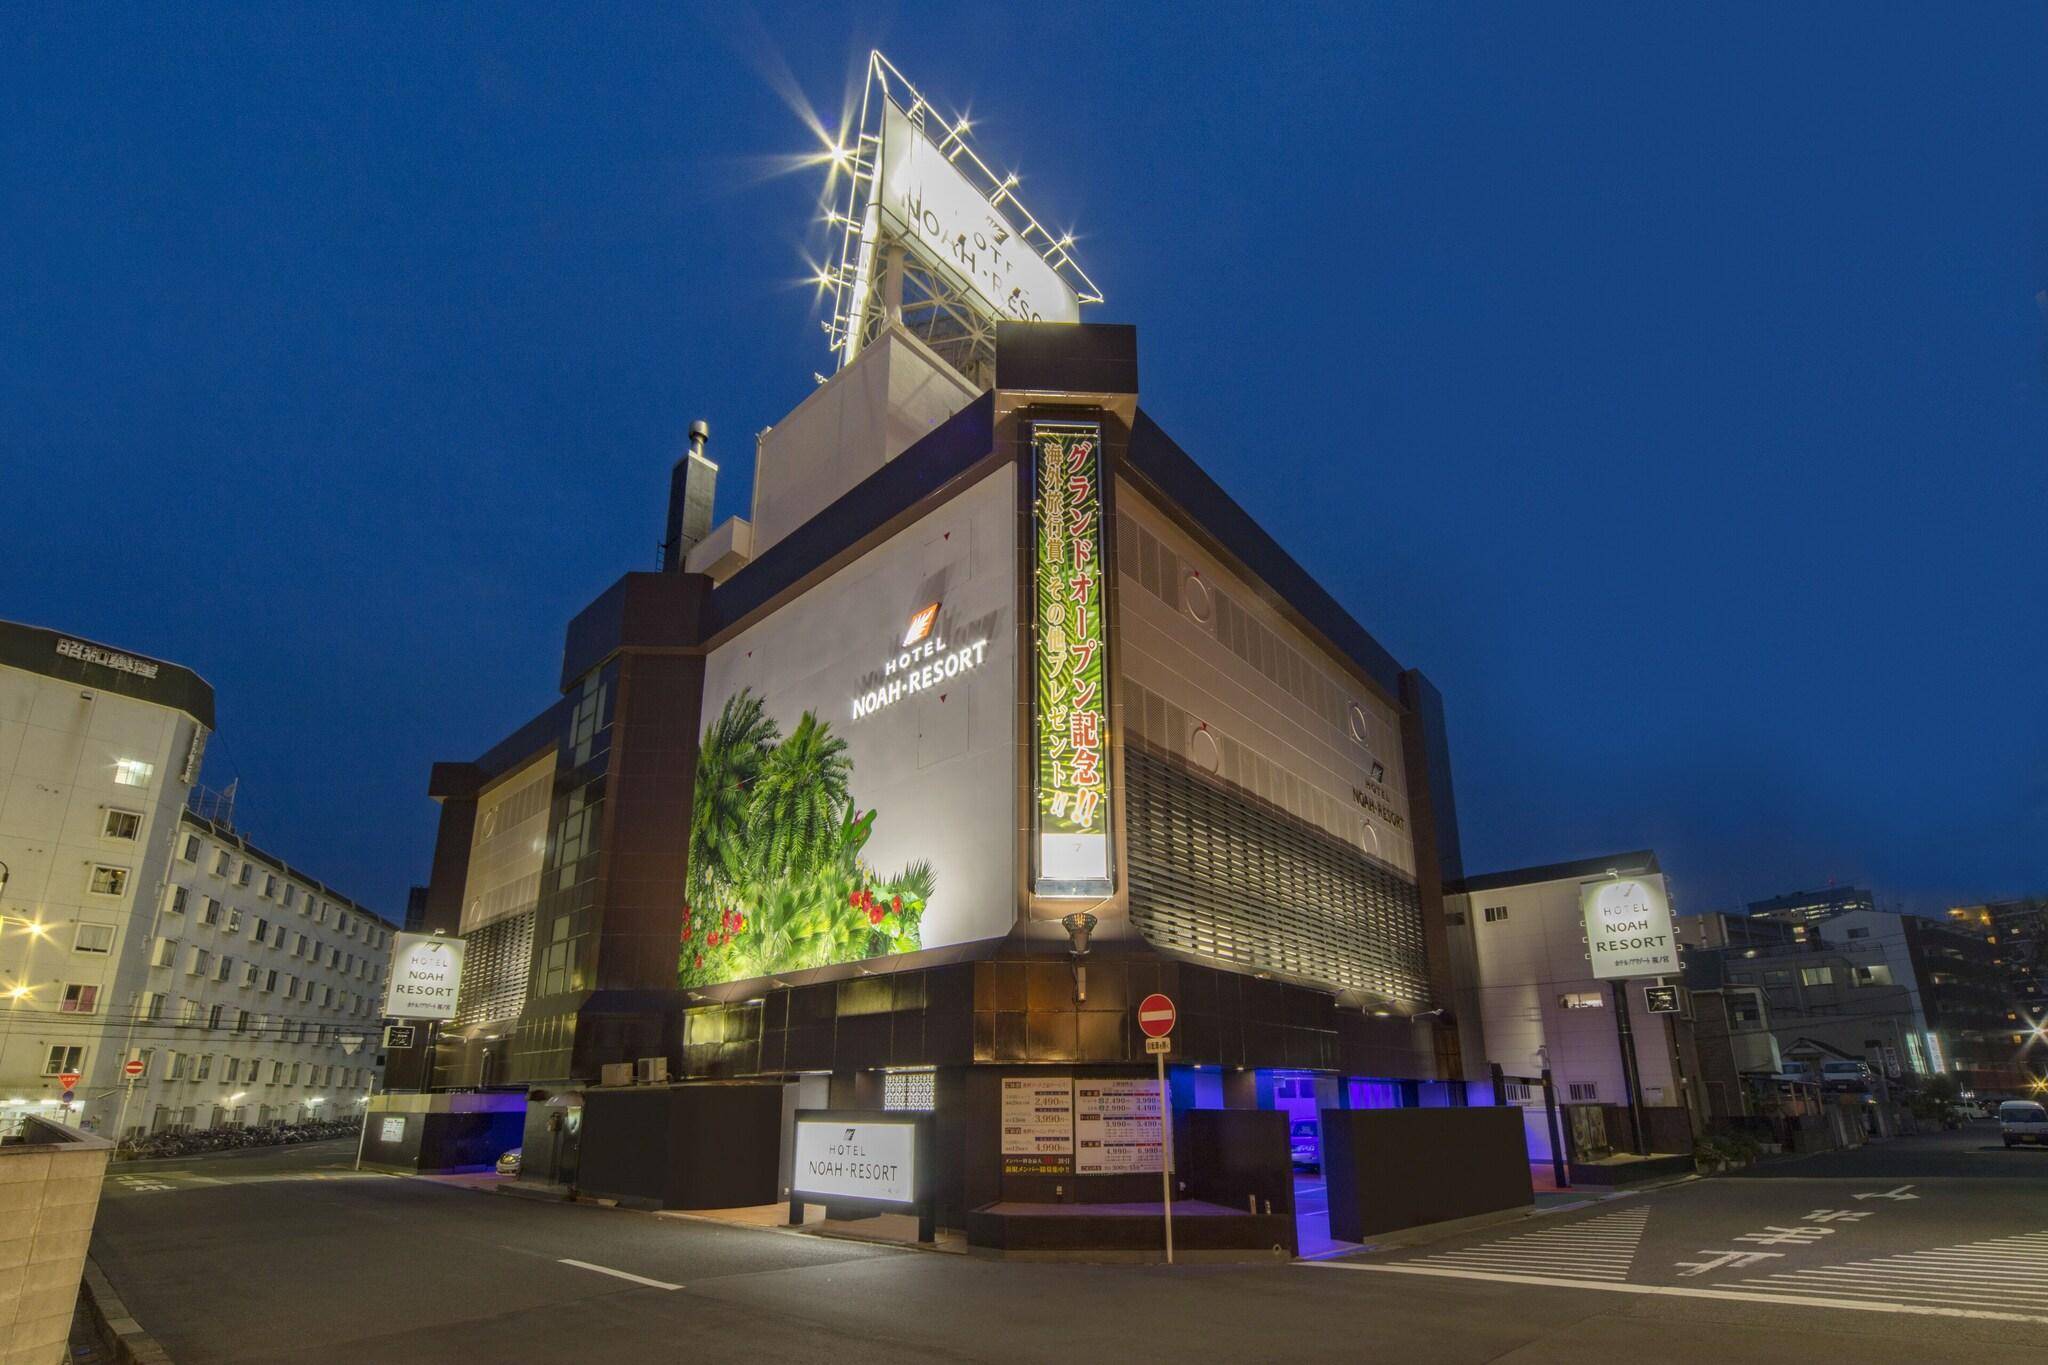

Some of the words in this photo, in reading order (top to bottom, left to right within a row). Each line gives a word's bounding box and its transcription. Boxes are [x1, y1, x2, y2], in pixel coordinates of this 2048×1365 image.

[885, 637, 947, 676] HOTEL
[1603, 903, 1649, 916] HOTEL
[1606, 919, 1649, 933] NOAH
[1596, 935, 1667, 952] RESORT
[408, 970, 445, 982] NOAH
[395, 984, 454, 998] RESORT
[829, 1144, 866, 1157] HOTEL
[1673, 1207, 1876, 1277] 止まれ
